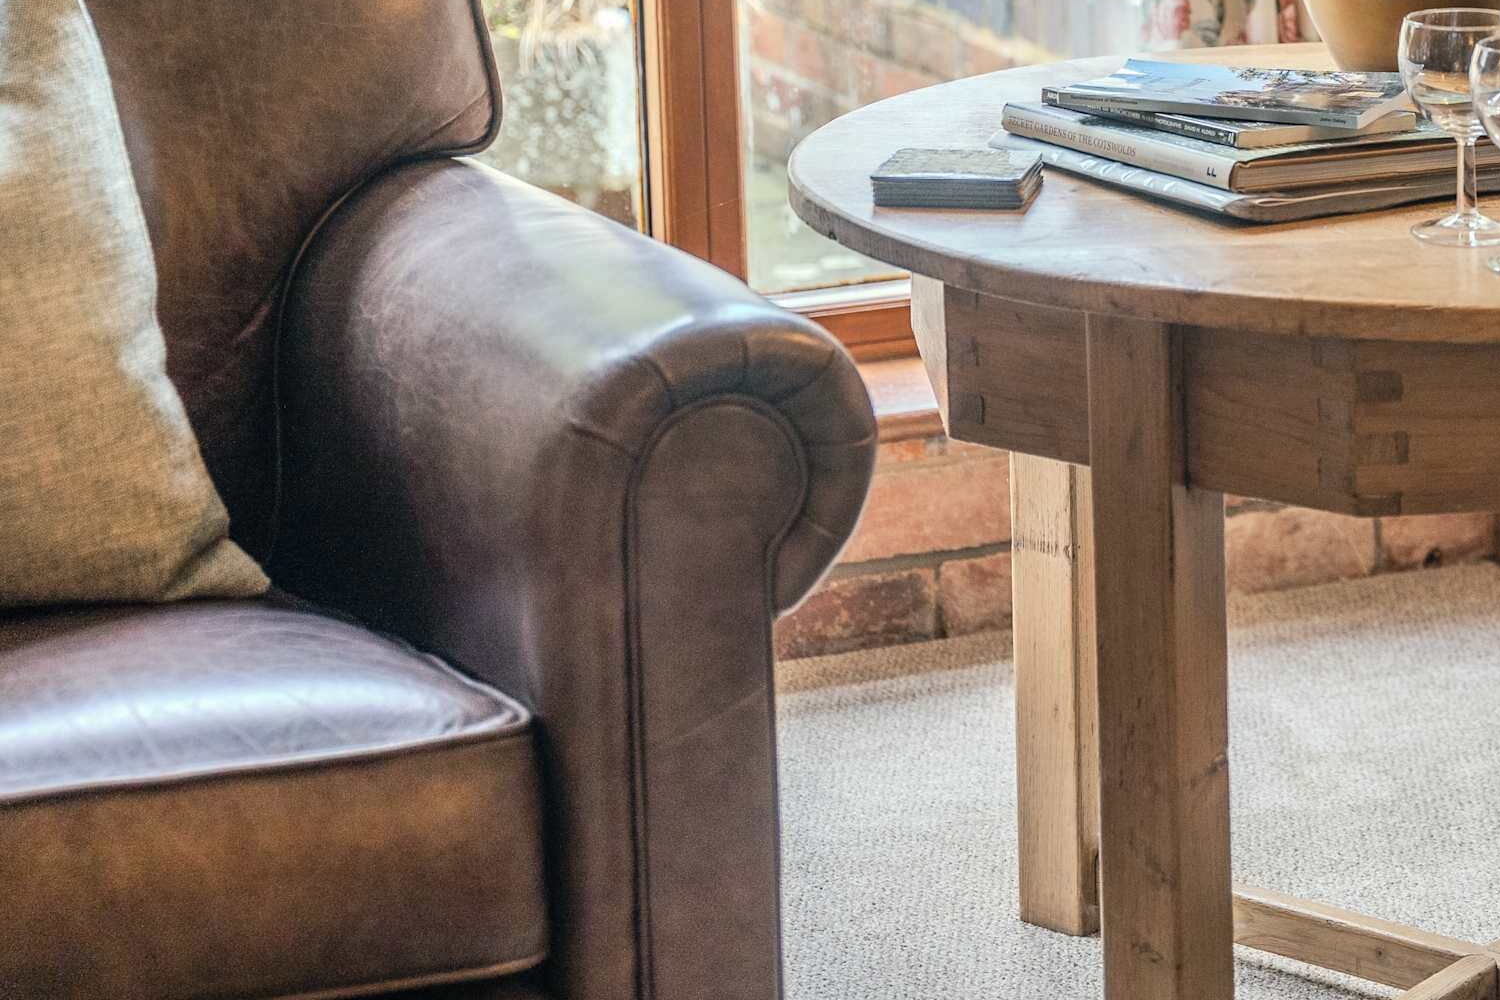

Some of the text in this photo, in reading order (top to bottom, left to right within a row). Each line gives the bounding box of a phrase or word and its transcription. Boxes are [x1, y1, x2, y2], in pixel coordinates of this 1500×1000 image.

[1034, 122, 1068, 139] GARDENS
[1068, 131, 1077, 140] OF
[1078, 133, 1093, 146] THE
[1093, 137, 1137, 156] COTSWOLDS
